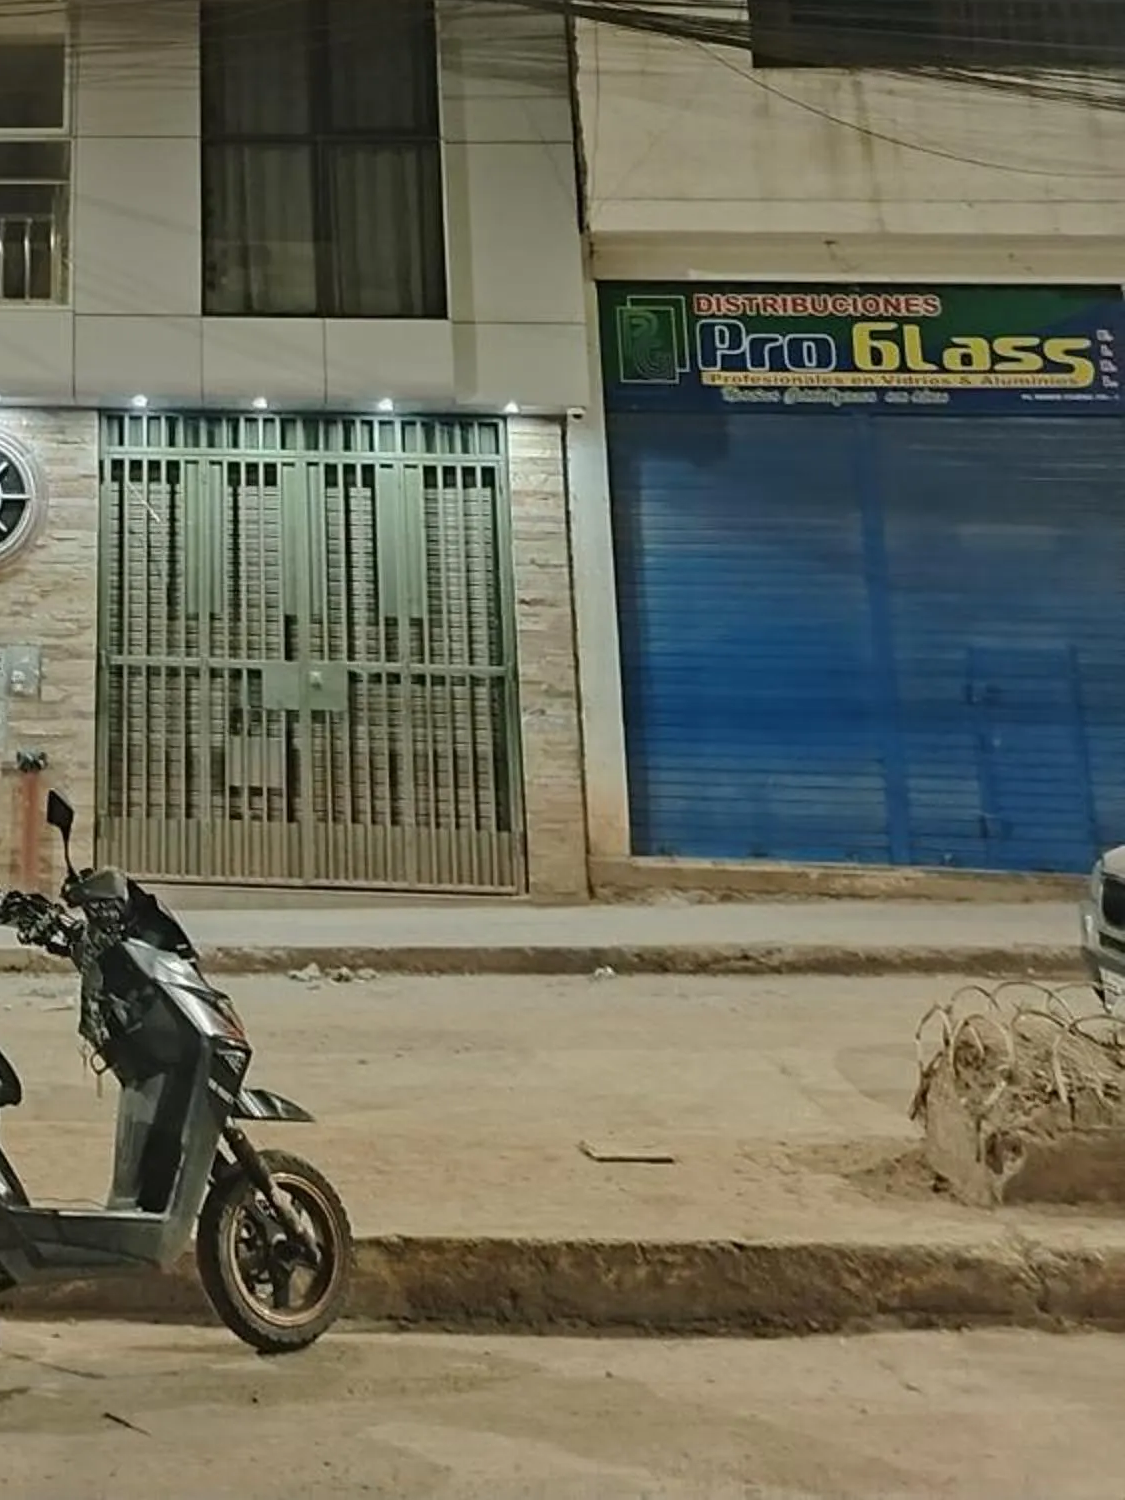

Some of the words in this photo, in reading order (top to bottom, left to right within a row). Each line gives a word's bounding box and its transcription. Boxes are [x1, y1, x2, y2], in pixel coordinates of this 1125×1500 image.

[694, 293, 940, 317] DISTRIBUCIONES
[697, 319, 837, 373] Pro
[710, 373, 845, 385] Profesionales
[879, 374, 952, 386] Vidrios
